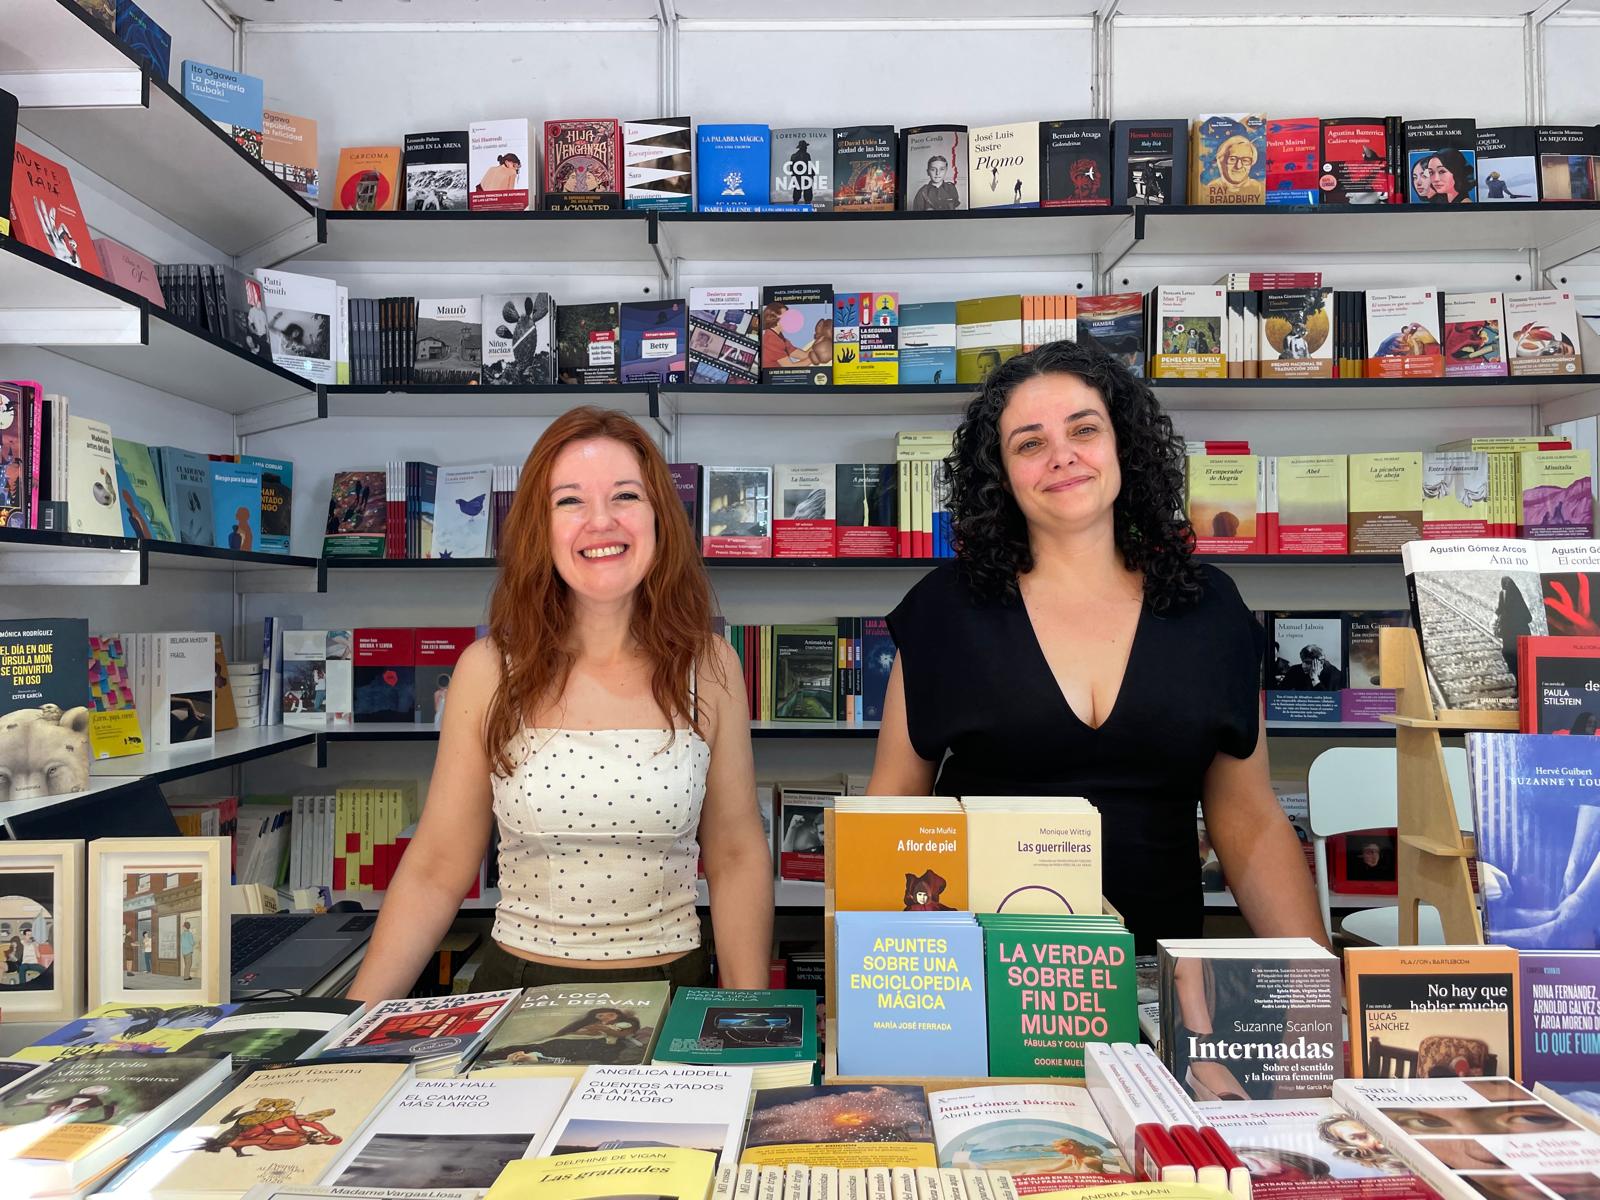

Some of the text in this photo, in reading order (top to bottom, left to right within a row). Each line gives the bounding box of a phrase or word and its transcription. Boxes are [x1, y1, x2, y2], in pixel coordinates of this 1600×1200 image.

[191, 64, 237, 83] Ito Ogawa
[191, 73, 245, 94] La papelería
[191, 82, 225, 97] Tsubaki
[567, 129, 594, 144] HIJA
[743, 135, 764, 143] MÁGICA
[975, 131, 1014, 143] José Luis
[1052, 131, 1101, 140] Bernardo Atxaga
[1328, 130, 1354, 138] Agustina
[1407, 130, 1433, 138] SPUTNIK,
[554, 142, 607, 162] VENGANZA
[975, 142, 1002, 153] Sastre
[349, 152, 389, 160] CARCOMA
[975, 154, 1024, 171] Plomo
[782, 161, 820, 176] CON
[775, 175, 827, 192] NADIE
[1209, 187, 1228, 196] RAY
[1209, 195, 1260, 204] BRADBURY
[263, 276, 281, 287] Patti
[263, 286, 286, 296] Smith
[1092, 320, 1115, 328] HAMBRE
[488, 339, 507, 348] Niñas
[650, 341, 669, 351] Betty
[488, 347, 511, 355] sucias
[1213, 469, 1243, 477] emperador
[1380, 466, 1404, 474] picadura
[1430, 544, 1527, 555] Agustín Gómez Arcos
[1489, 555, 1529, 565] Ana no
[1278, 622, 1324, 631] Manuel Jabois
[1352, 622, 1369, 630] Elena
[0, 629, 53, 638] MÓNICA RODRÍGUEZ
[170, 637, 188, 645] BELINDA
[0, 643, 53, 656] EL DÍA EN QUE
[2, 654, 51, 666] ÚRSULA MON
[1, 663, 53, 676] SE CONVIRTIÓ
[13, 675, 41, 686] EN OSO
[27, 691, 43, 700] GARCÍA
[1544, 688, 1569, 697] PAULA
[1544, 698, 1582, 706] STILSTEIN
[1536, 766, 1592, 776] Hervé Guibert
[920, 826, 957, 835] Nora Muñiz
[1040, 828, 1092, 837] Monique Wittig
[897, 840, 957, 855] A flor de piel
[1018, 841, 1092, 855] Las guerrilleras
[873, 938, 947, 954] APUNTES
[999, 943, 1125, 966] LA VERDAD
[863, 956, 958, 973] SOBRE UNA
[850, 974, 972, 992] ENCICLOPEDIA
[1008, 966, 1118, 990] SOBRE EL
[1428, 984, 1508, 1000] No hay que
[1533, 983, 1598, 1000] NONA FERNÁNDEZ,
[877, 989, 945, 1010] MÁGICA
[1021, 990, 1106, 1013] FIN DEL
[1410, 1000, 1508, 1013] hablar mucho
[1533, 1000, 1594, 1016] ARNOLDO GÁLVEZ
[1368, 1012, 1397, 1021] LUCAS
[873, 1020, 952, 1031] MARÍA JOSÉ FERRADA
[1021, 1014, 1108, 1037] MUNDO
[1234, 1019, 1333, 1032] Suzanne Scanlon
[1369, 1021, 1410, 1031] SÁNCHEZ
[1534, 1015, 1593, 1030] Y AROA MORENO
[1187, 1036, 1334, 1060] Internadas
[1535, 1032, 1549, 1054] LO
[1551, 1033, 1572, 1055] QUE
[596, 1067, 733, 1077] ANGÉLICA LIDDELL
[1263, 1063, 1334, 1072] Sobre el sentido
[589, 1081, 725, 1091] CUENTOS ATADOS
[1354, 1085, 1397, 1094] Sara
[399, 1099, 490, 1108] MÁS LARGO
[630, 1095, 674, 1104] LOBO
[1365, 1093, 1468, 1104] Barquinero
[939, 1097, 1076, 1113] Juan Gómez Bárcena
[539, 1164, 671, 1183] Las gratitudes
